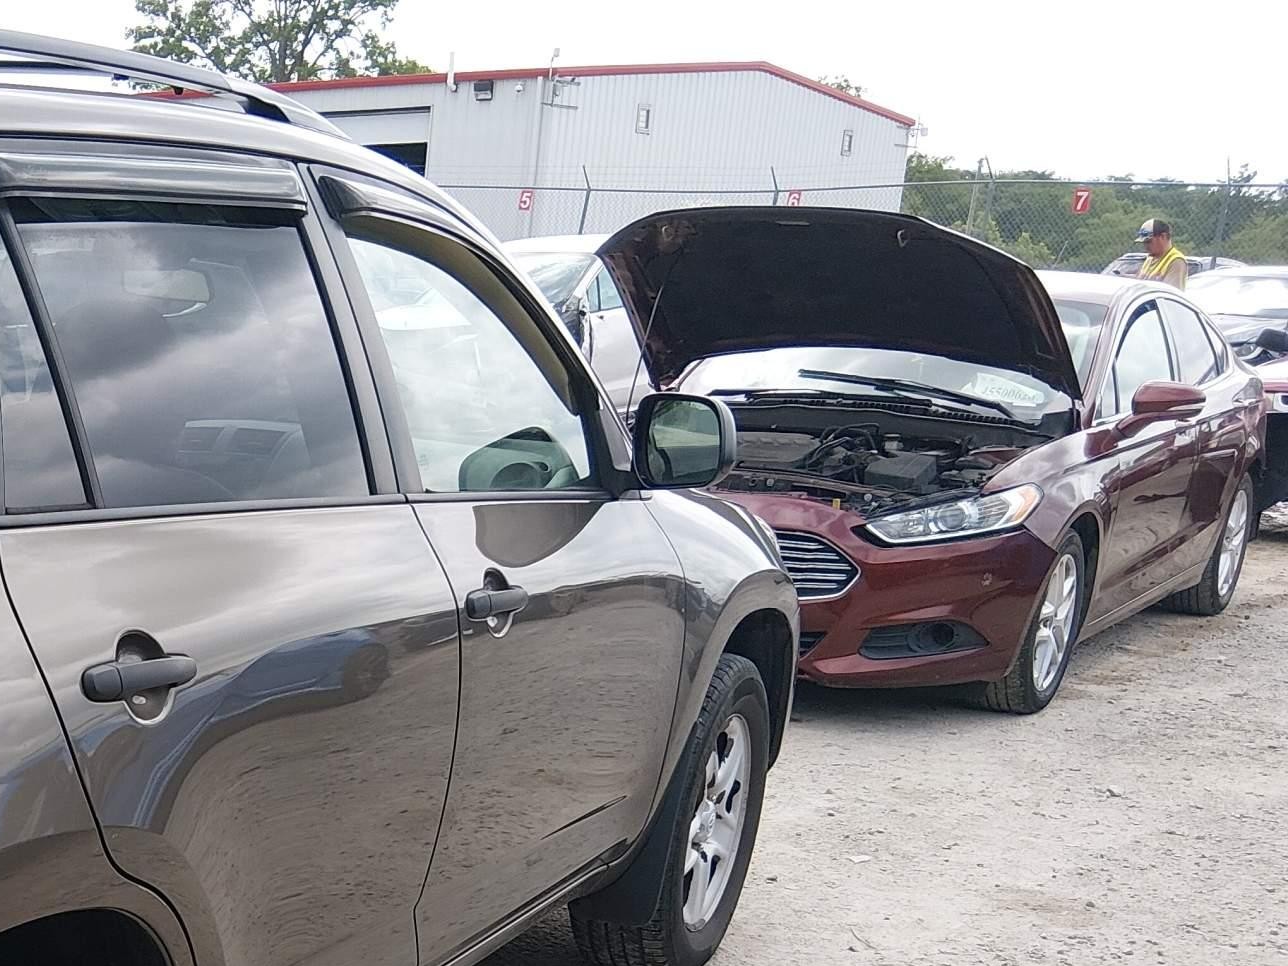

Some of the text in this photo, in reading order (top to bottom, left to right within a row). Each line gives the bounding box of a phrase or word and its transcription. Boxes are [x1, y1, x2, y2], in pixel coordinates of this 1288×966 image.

[519, 192, 532, 209] 5
[787, 192, 800, 207] 6
[1076, 191, 1089, 210] 7
